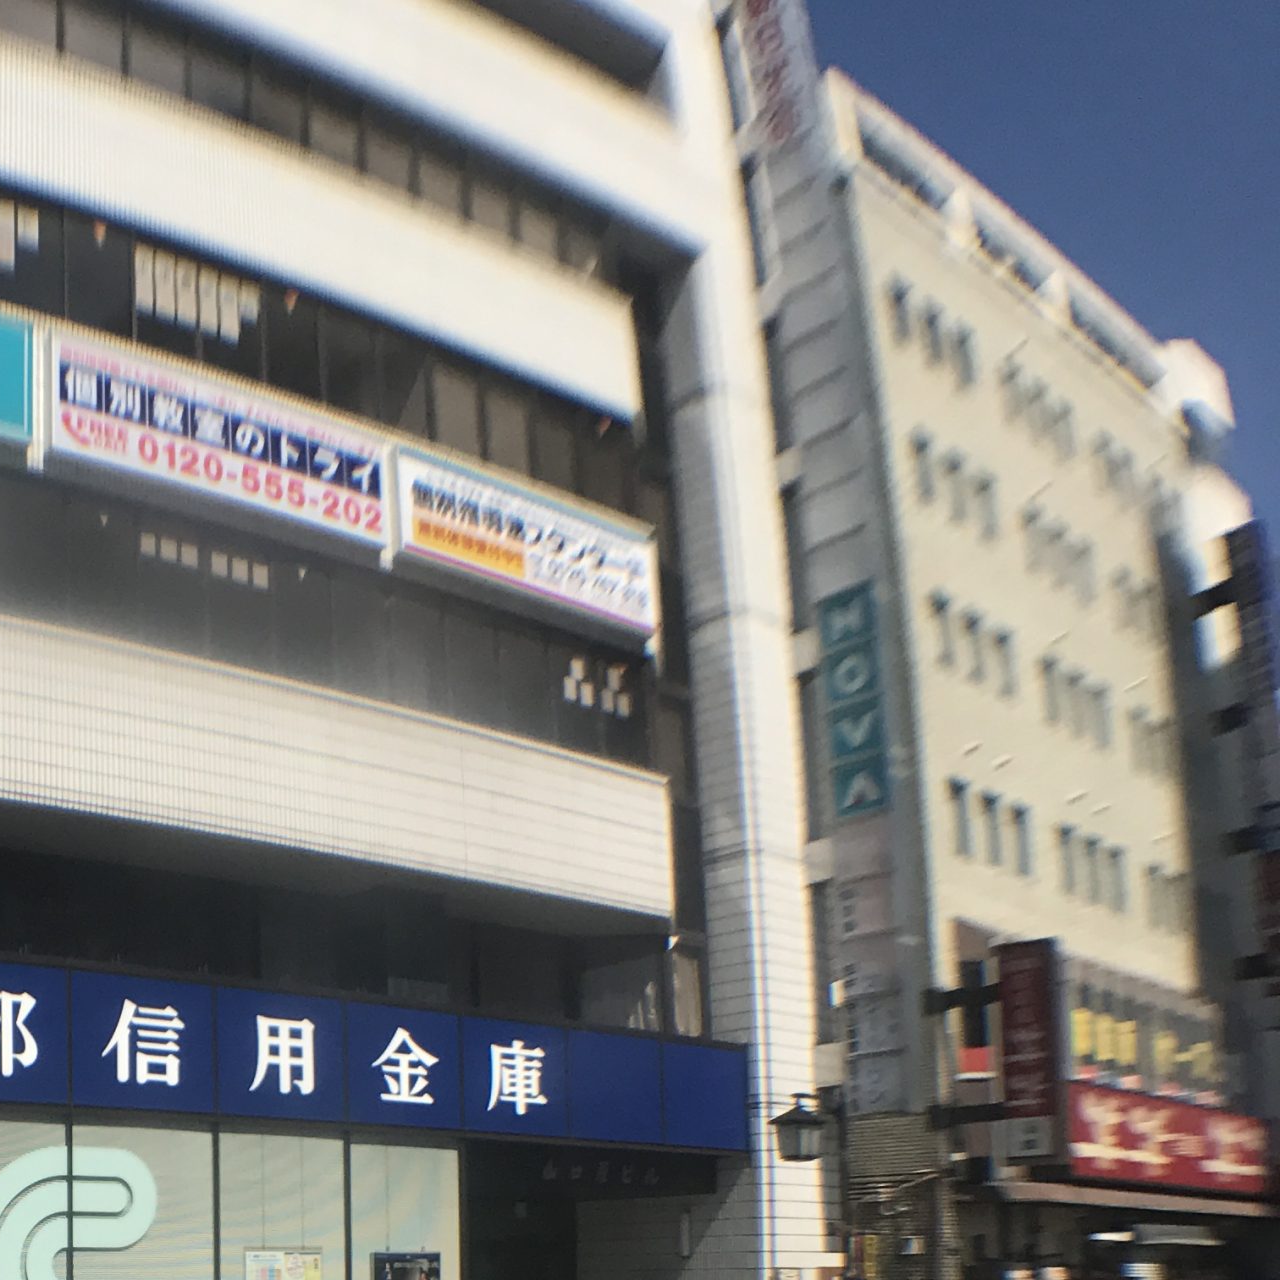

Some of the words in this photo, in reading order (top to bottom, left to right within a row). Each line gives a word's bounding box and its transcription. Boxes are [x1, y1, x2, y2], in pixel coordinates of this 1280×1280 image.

[64, 364, 380, 496] 個別教室のトライ
[137, 432, 383, 534] 0120-555-202
